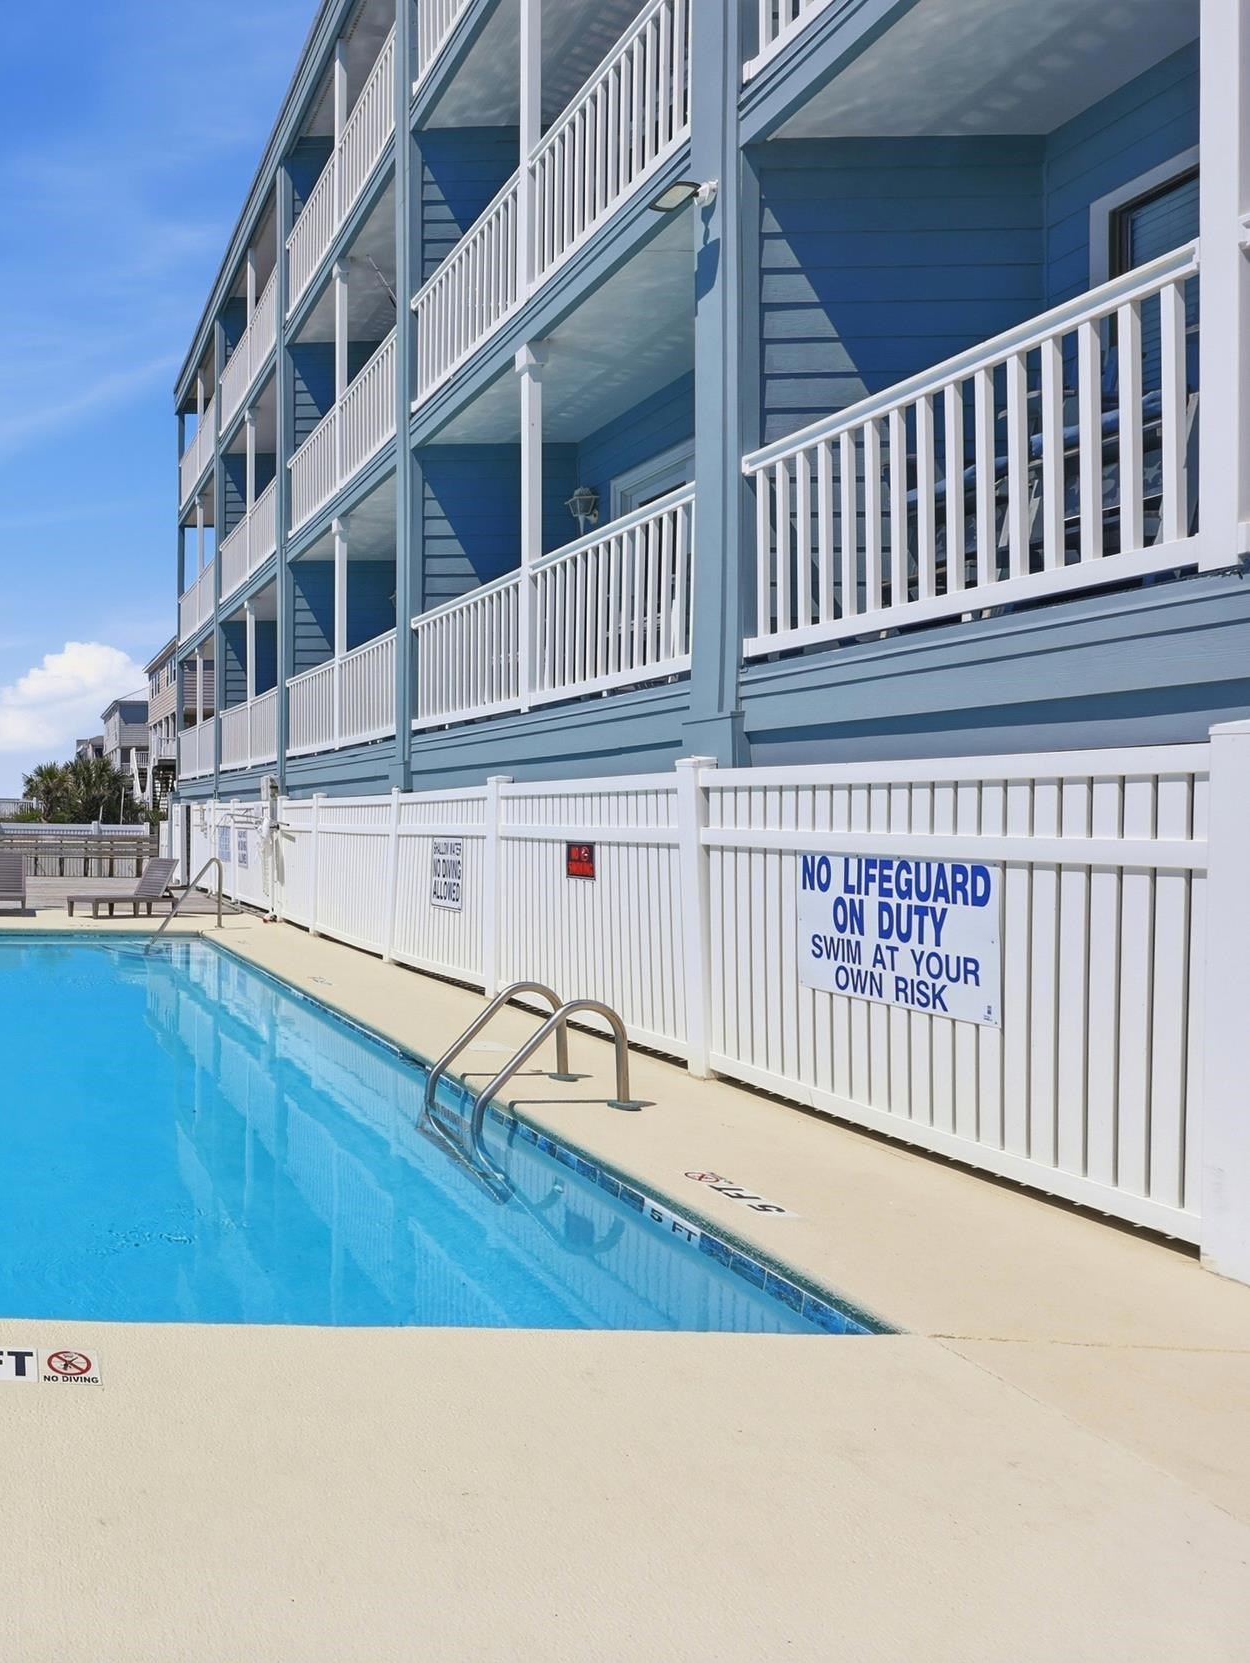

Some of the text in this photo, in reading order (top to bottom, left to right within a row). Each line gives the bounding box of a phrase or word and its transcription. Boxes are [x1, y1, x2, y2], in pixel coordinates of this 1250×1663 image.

[433, 858, 441, 878] NO
[802, 855, 991, 907] NO LIFEGUARD
[432, 879, 461, 902] ALLOWED
[833, 896, 948, 947] ON DUTY
[811, 934, 980, 987] SWIM AT YOUR
[835, 965, 948, 1012] OWN RISK
[709, 1184, 786, 1213] 5 FT
[650, 1207, 697, 1242] 5 FT
[43, 1375, 99, 1384] NO DIVING
